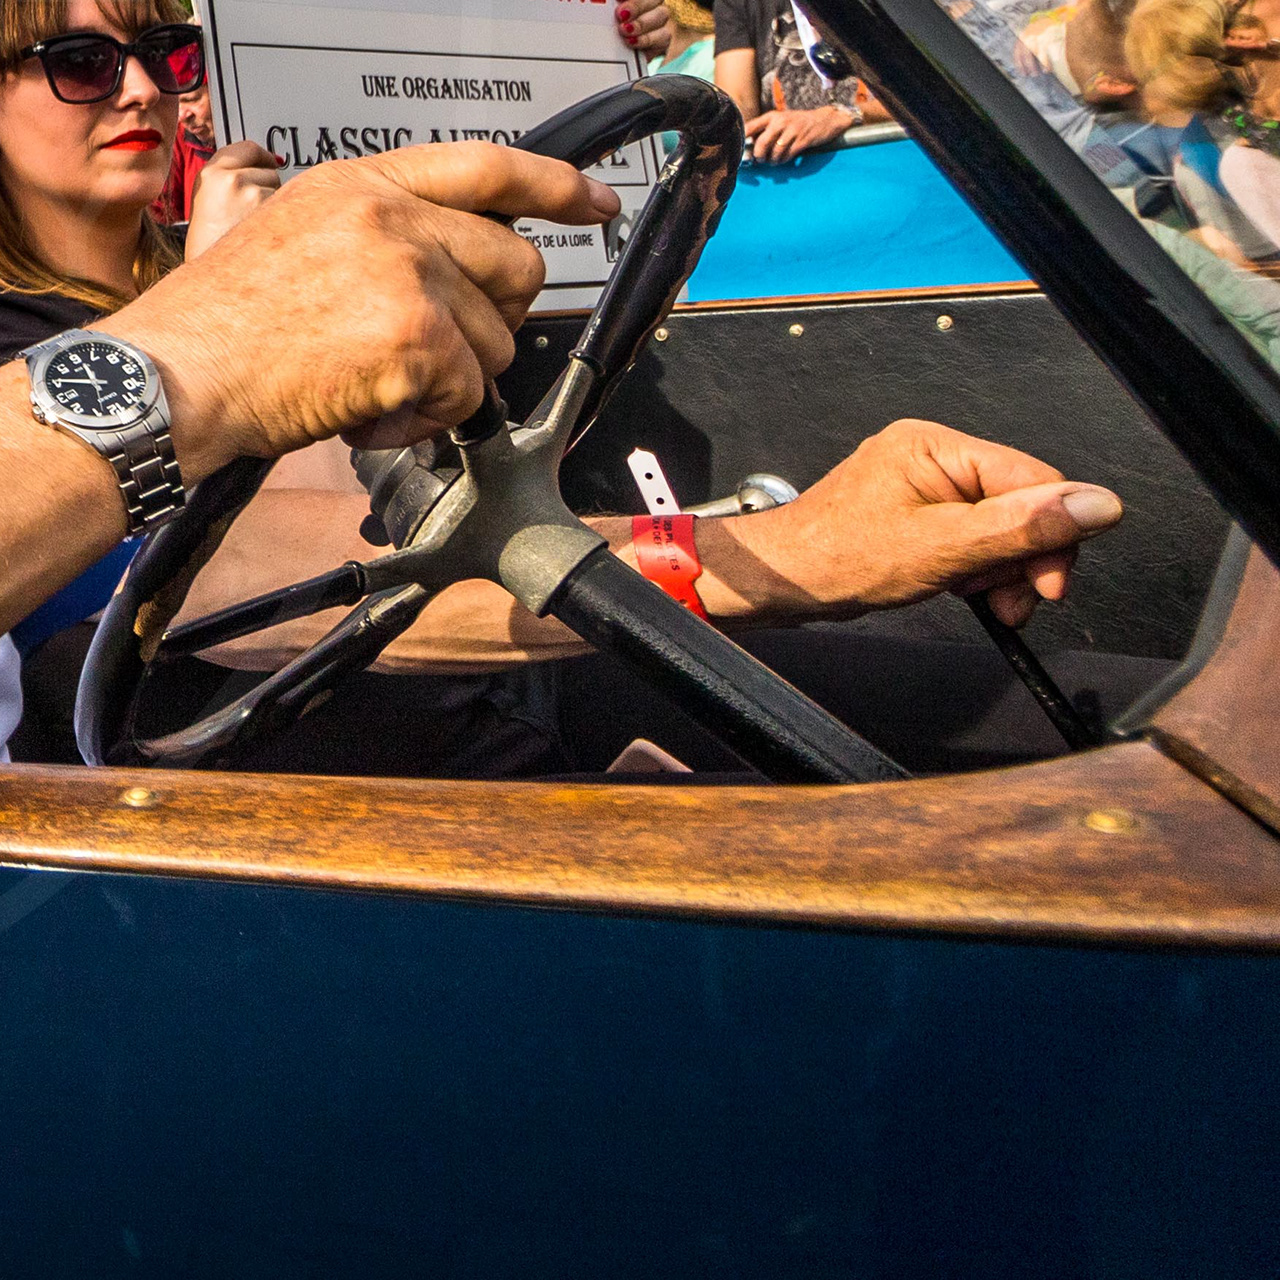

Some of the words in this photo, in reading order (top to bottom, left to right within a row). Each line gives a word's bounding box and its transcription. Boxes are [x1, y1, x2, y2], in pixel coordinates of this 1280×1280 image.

[360, 74, 400, 99] UNE
[401, 76, 532, 102] ORGANISATION
[543, 234, 555, 249] DE
[555, 233, 569, 248] LA
[569, 233, 595, 248] LOIRE
